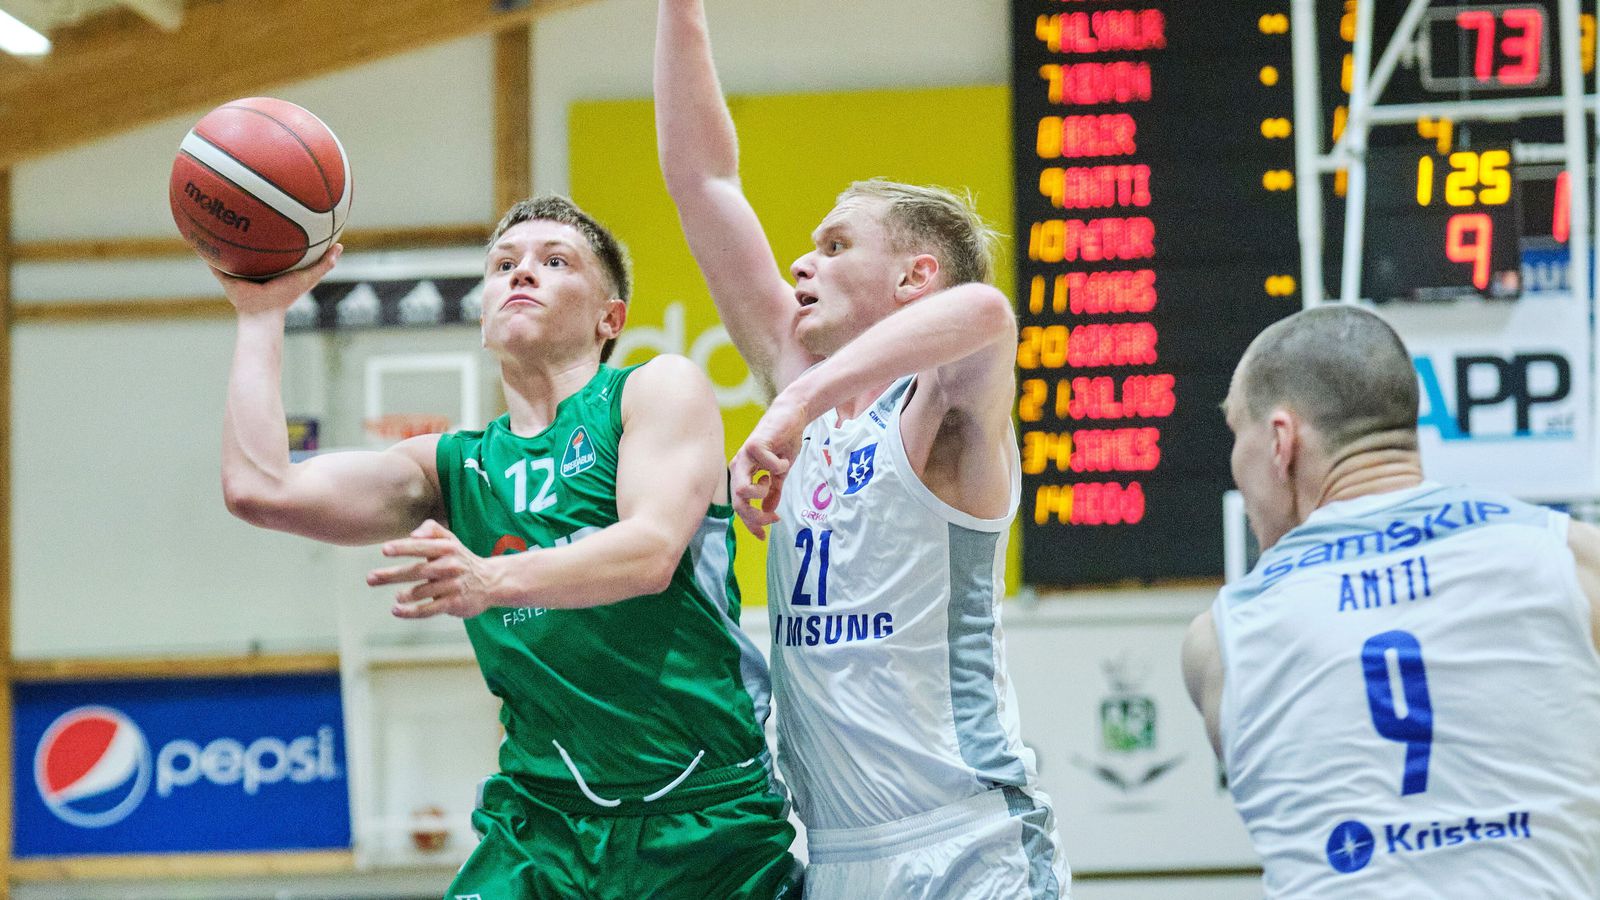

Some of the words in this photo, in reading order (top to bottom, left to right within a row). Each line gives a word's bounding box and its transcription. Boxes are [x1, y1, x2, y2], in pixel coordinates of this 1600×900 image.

[1456, 9, 1542, 85] 73
[184, 180, 250, 233] molten
[1446, 213, 1493, 290] 9
[1017, 325, 1069, 369] 20
[1019, 378, 1071, 422] 21
[504, 457, 558, 514] 12
[791, 527, 833, 607] 21
[1361, 629, 1434, 797] 9
[157, 724, 337, 798] pepsi
[1385, 812, 1531, 853] Kristall
